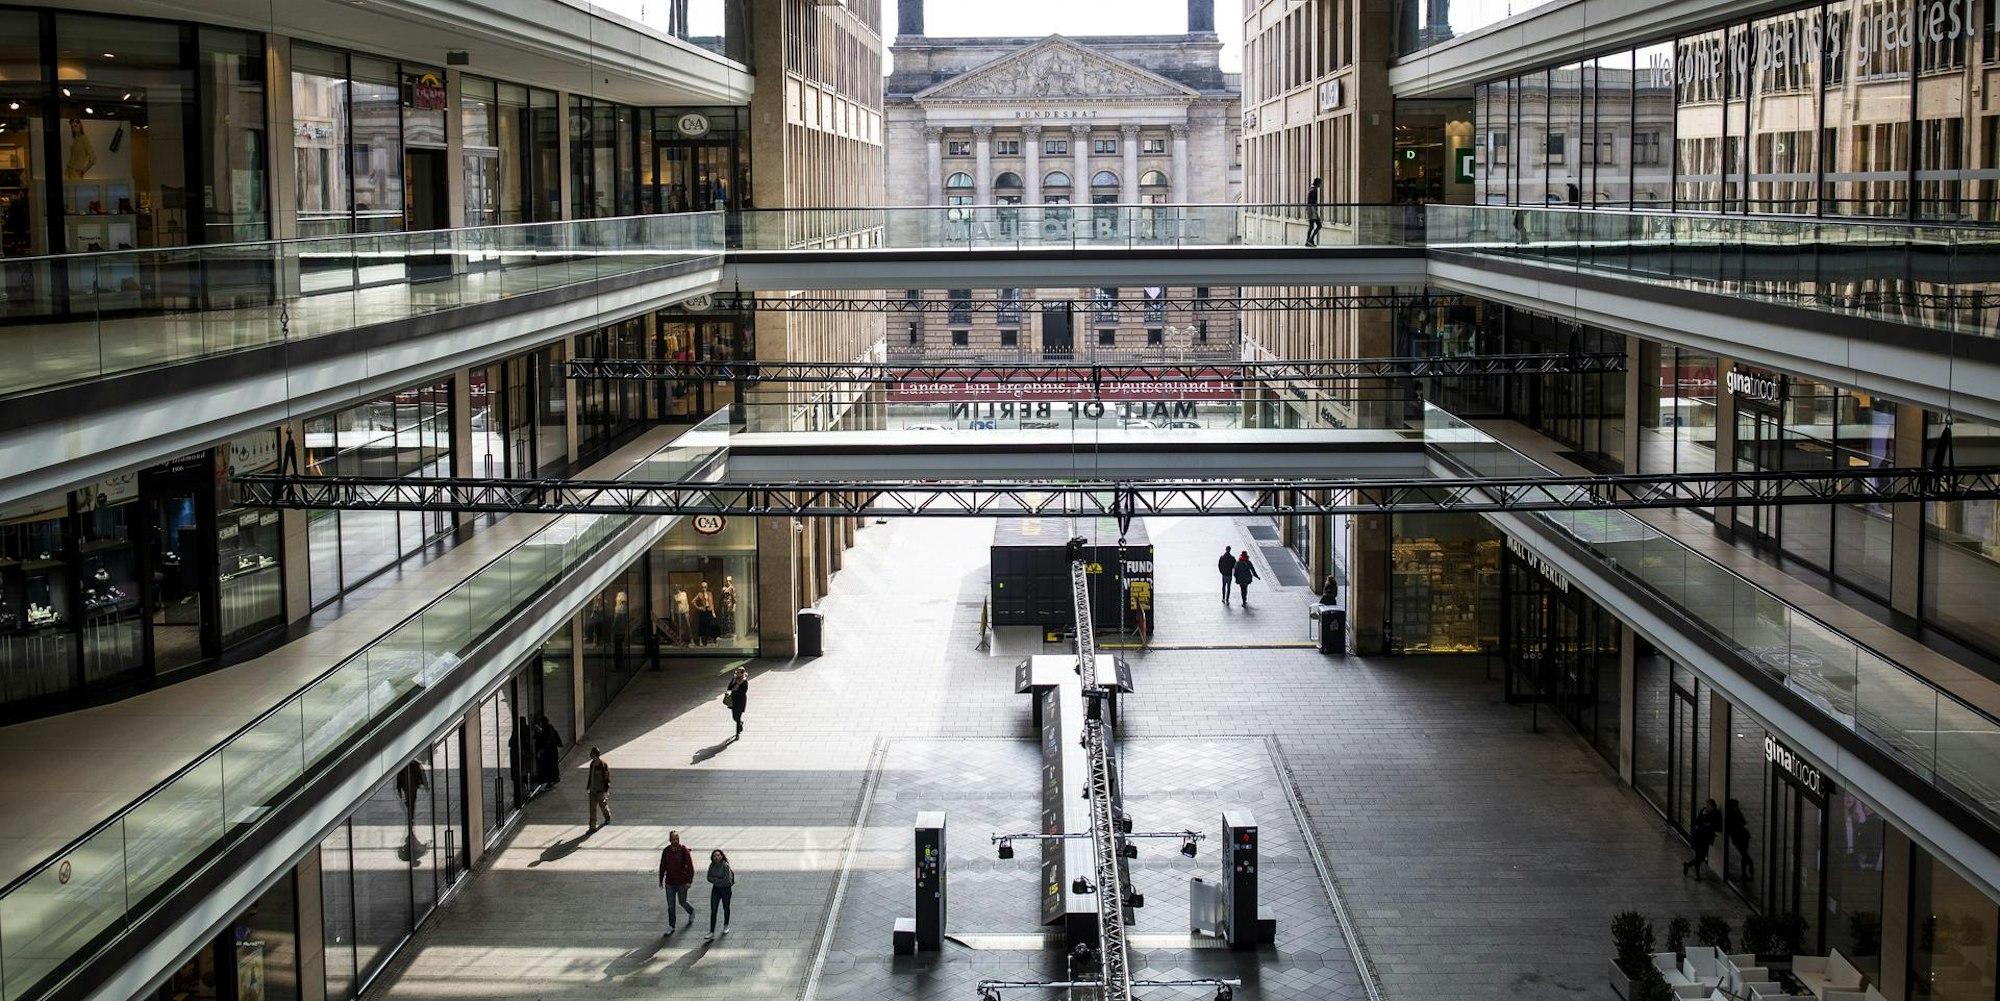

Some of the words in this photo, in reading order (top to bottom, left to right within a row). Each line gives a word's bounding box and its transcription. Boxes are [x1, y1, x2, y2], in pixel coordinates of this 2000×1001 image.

[1649, 47, 1721, 89] Wecome
[1729, 35, 1747, 75] to
[1857, 0, 1975, 67] greatest
[1015, 110, 1098, 120] BUNDESRAT
[682, 117, 704, 131] C&A
[686, 295, 709, 306] C&A
[697, 517, 719, 529] C&A
[1126, 560, 1153, 573] FUND
[1506, 536, 1525, 561] MALL
[1540, 559, 1569, 594] BERLIN
